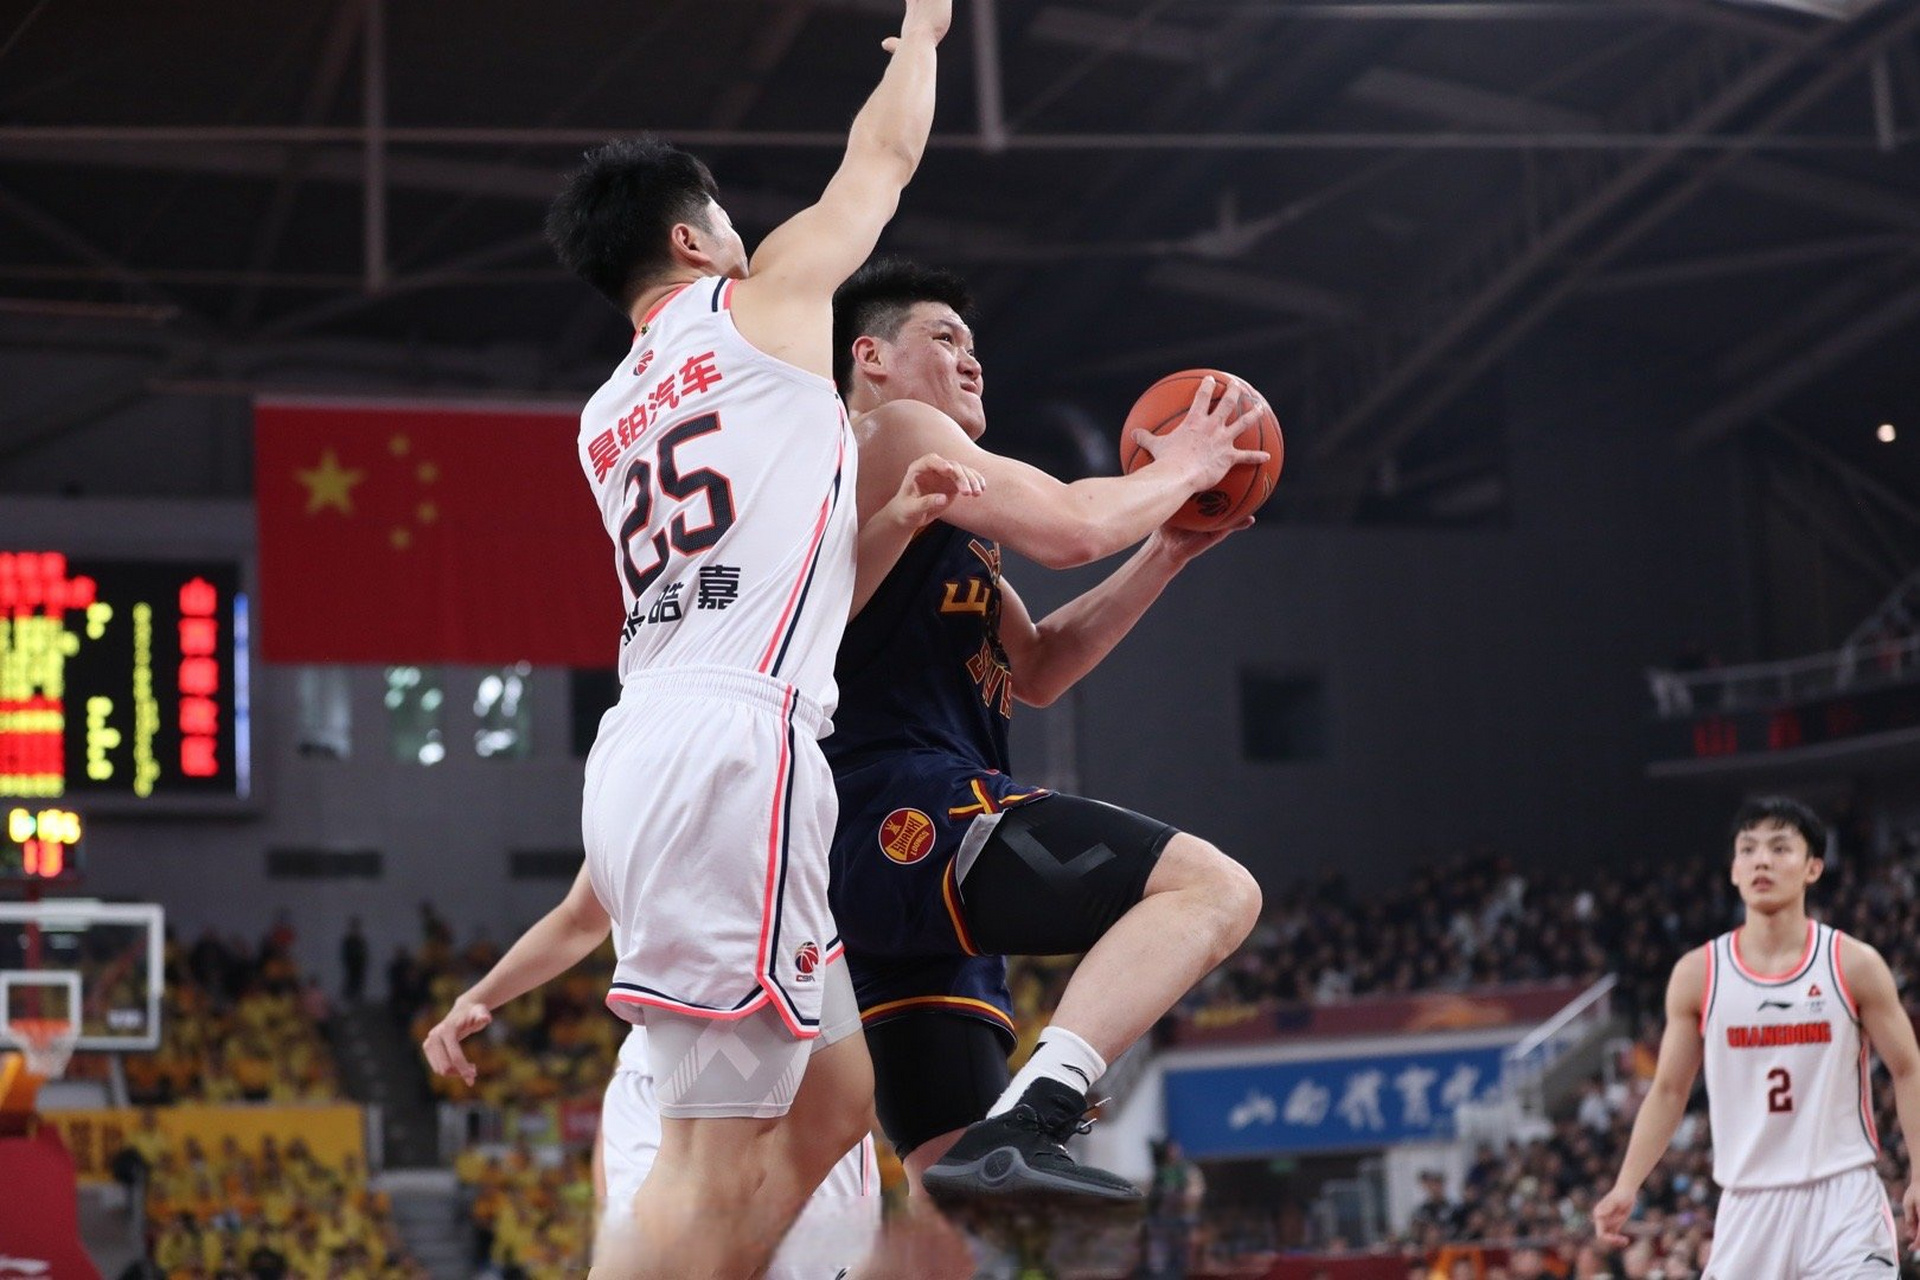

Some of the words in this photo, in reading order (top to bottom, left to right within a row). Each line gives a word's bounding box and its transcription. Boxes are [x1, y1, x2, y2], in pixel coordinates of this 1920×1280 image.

[588, 351, 722, 484] 昊铂汽车
[620, 411, 737, 601] 25
[890, 815, 924, 856] SHANXI
[795, 974, 816, 982] CBA
[1727, 1020, 1832, 1049] GUANGDONG
[1767, 1068, 1793, 1113] 2
